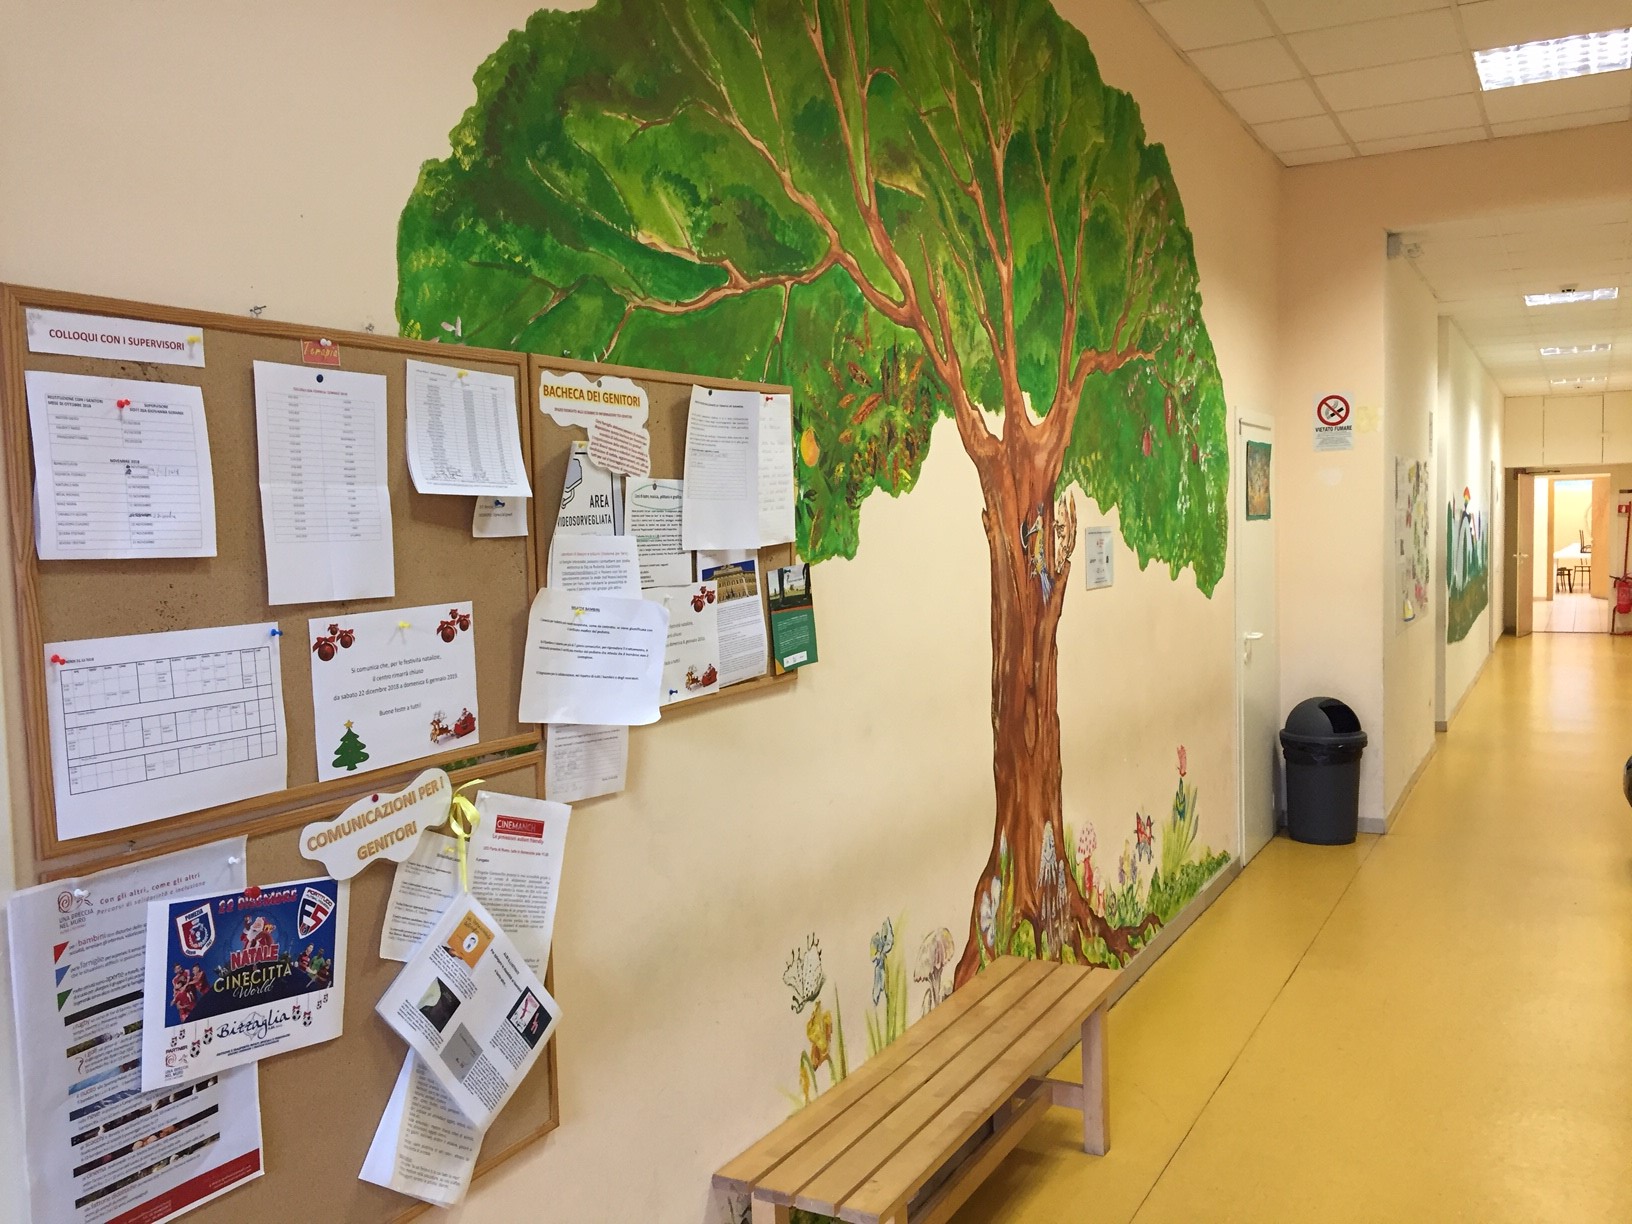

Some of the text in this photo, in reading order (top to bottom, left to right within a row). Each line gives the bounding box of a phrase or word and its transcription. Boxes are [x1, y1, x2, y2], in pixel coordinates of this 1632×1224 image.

[49, 329, 185, 351] COLLOQUI CON I SUPERVISORI
[543, 384, 641, 407] BACHECA DEI GENITORI
[590, 494, 609, 508] AREA
[557, 514, 612, 527] VIDEOSORVEGLIATA
[356, 665, 379, 674] comunica
[390, 660, 398, 669] per
[376, 673, 392, 682] centro
[392, 671, 409, 679] rimarrà
[409, 668, 424, 677] chiuso
[341, 691, 358, 700] sabato
[365, 686, 387, 696] dicembre
[403, 680, 425, 689] domenica
[429, 676, 447, 686] gennaio
[379, 708, 394, 717] Buone
[307, 776, 445, 852] COMUNICAZIONI PER I
[357, 820, 418, 861] GENITORI
[99, 872, 200, 905] Con gli altri, come gli altri
[96, 904, 124, 917] Percorsi
[125, 900, 133, 908] di
[174, 880, 206, 894] inclusione
[218, 898, 234, 914] 22
[58, 909, 94, 925] UNA BRECCIA
[59, 917, 87, 930] NEL MURO
[77, 933, 107, 947] bambini
[230, 943, 280, 972] NATALE
[232, 976, 275, 998] World
[216, 1008, 291, 1042] Bizzaglia
[165, 1044, 188, 1055] PARTNER
